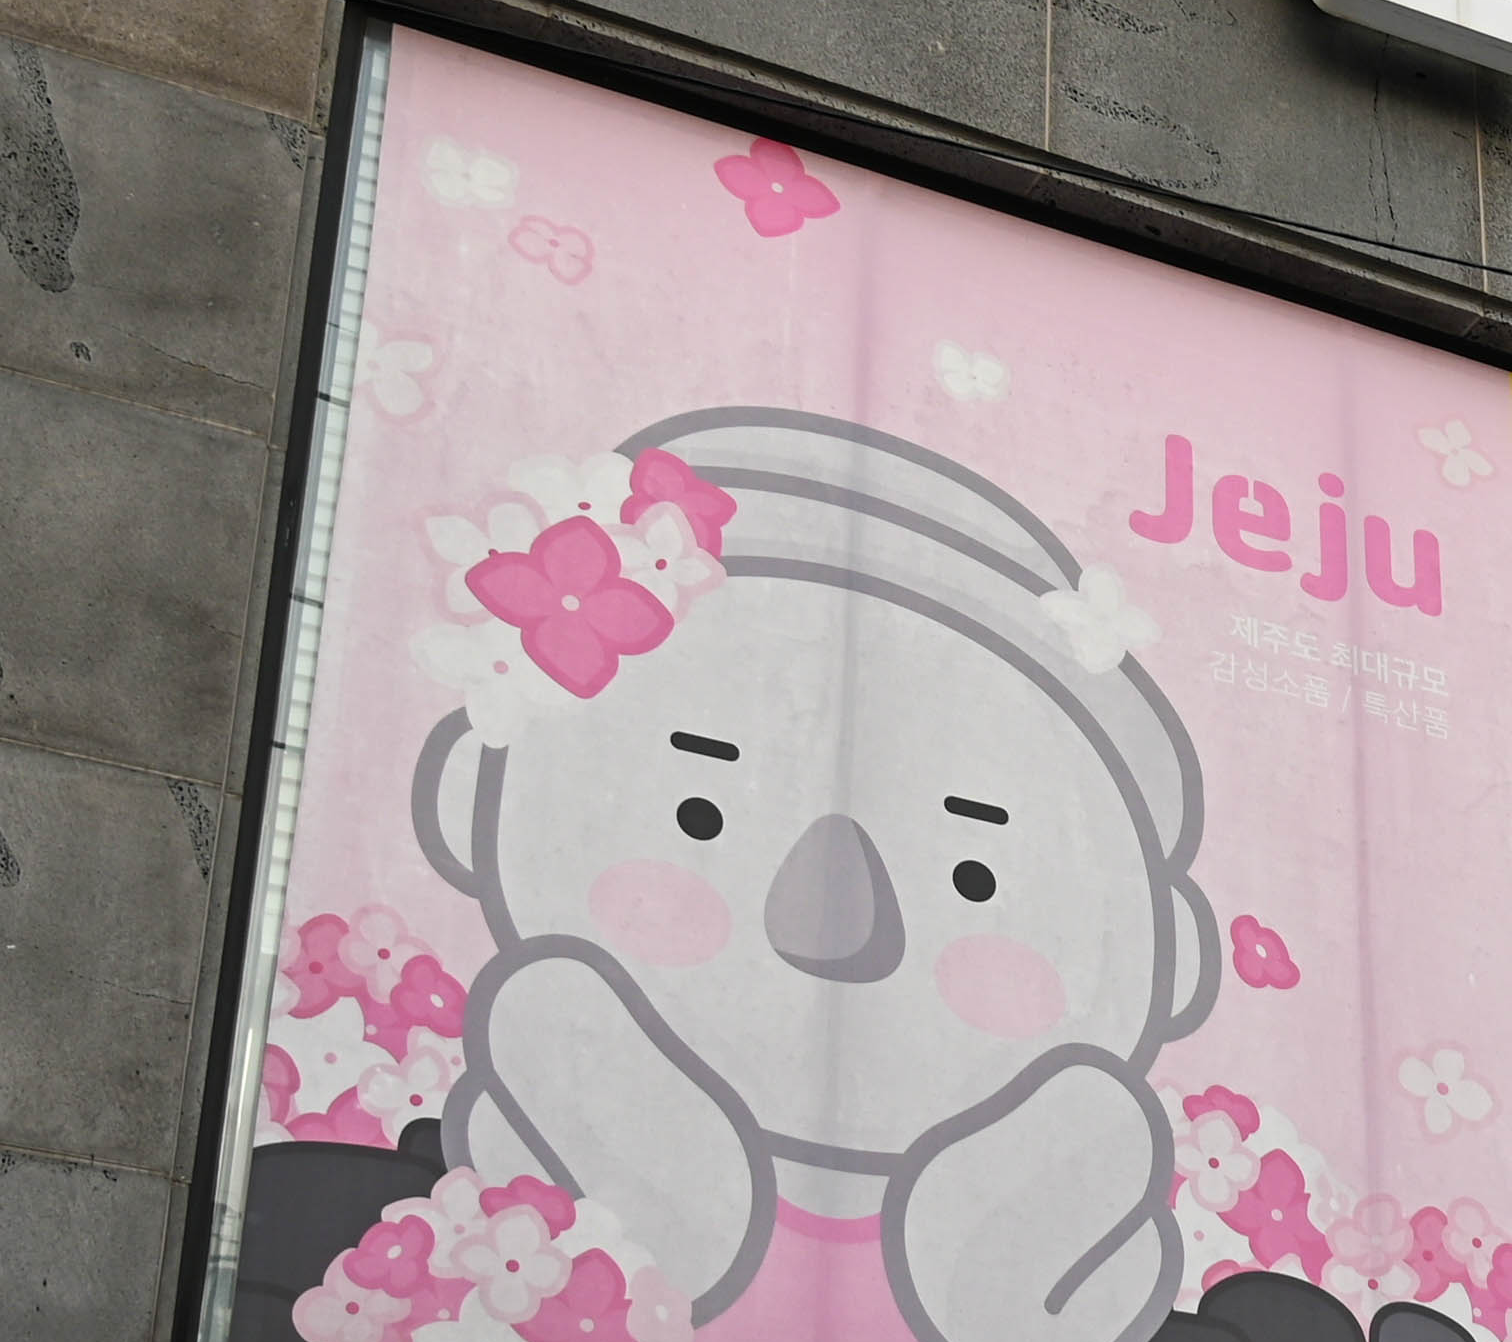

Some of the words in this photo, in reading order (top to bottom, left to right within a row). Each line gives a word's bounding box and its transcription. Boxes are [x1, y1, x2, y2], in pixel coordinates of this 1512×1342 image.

[1129, 434, 1443, 617] Jeju
[1208, 650, 1331, 708] 감성소품
[1362, 689, 1449, 740] 특산품
[1229, 612, 1321, 662] 제주도
[1328, 642, 1449, 696] 최대규모
